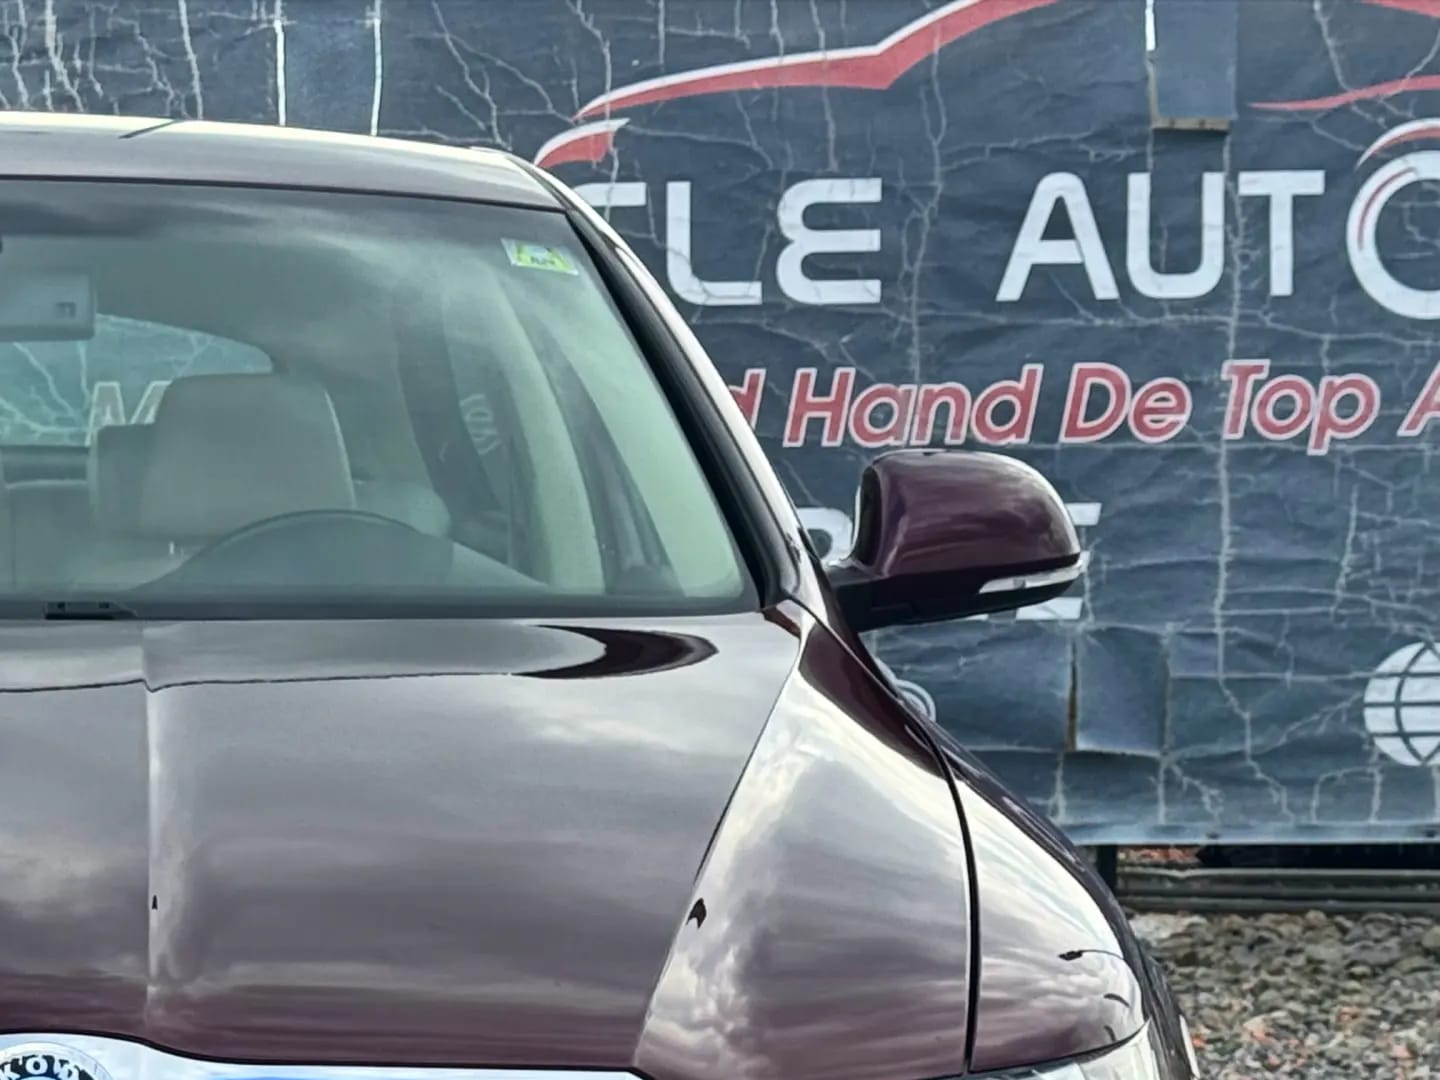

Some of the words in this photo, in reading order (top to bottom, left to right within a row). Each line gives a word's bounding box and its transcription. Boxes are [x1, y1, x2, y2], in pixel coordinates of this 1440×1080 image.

[783, 365, 1044, 448] Hand
[1060, 361, 1191, 445] De
[1221, 359, 1380, 456] Top
